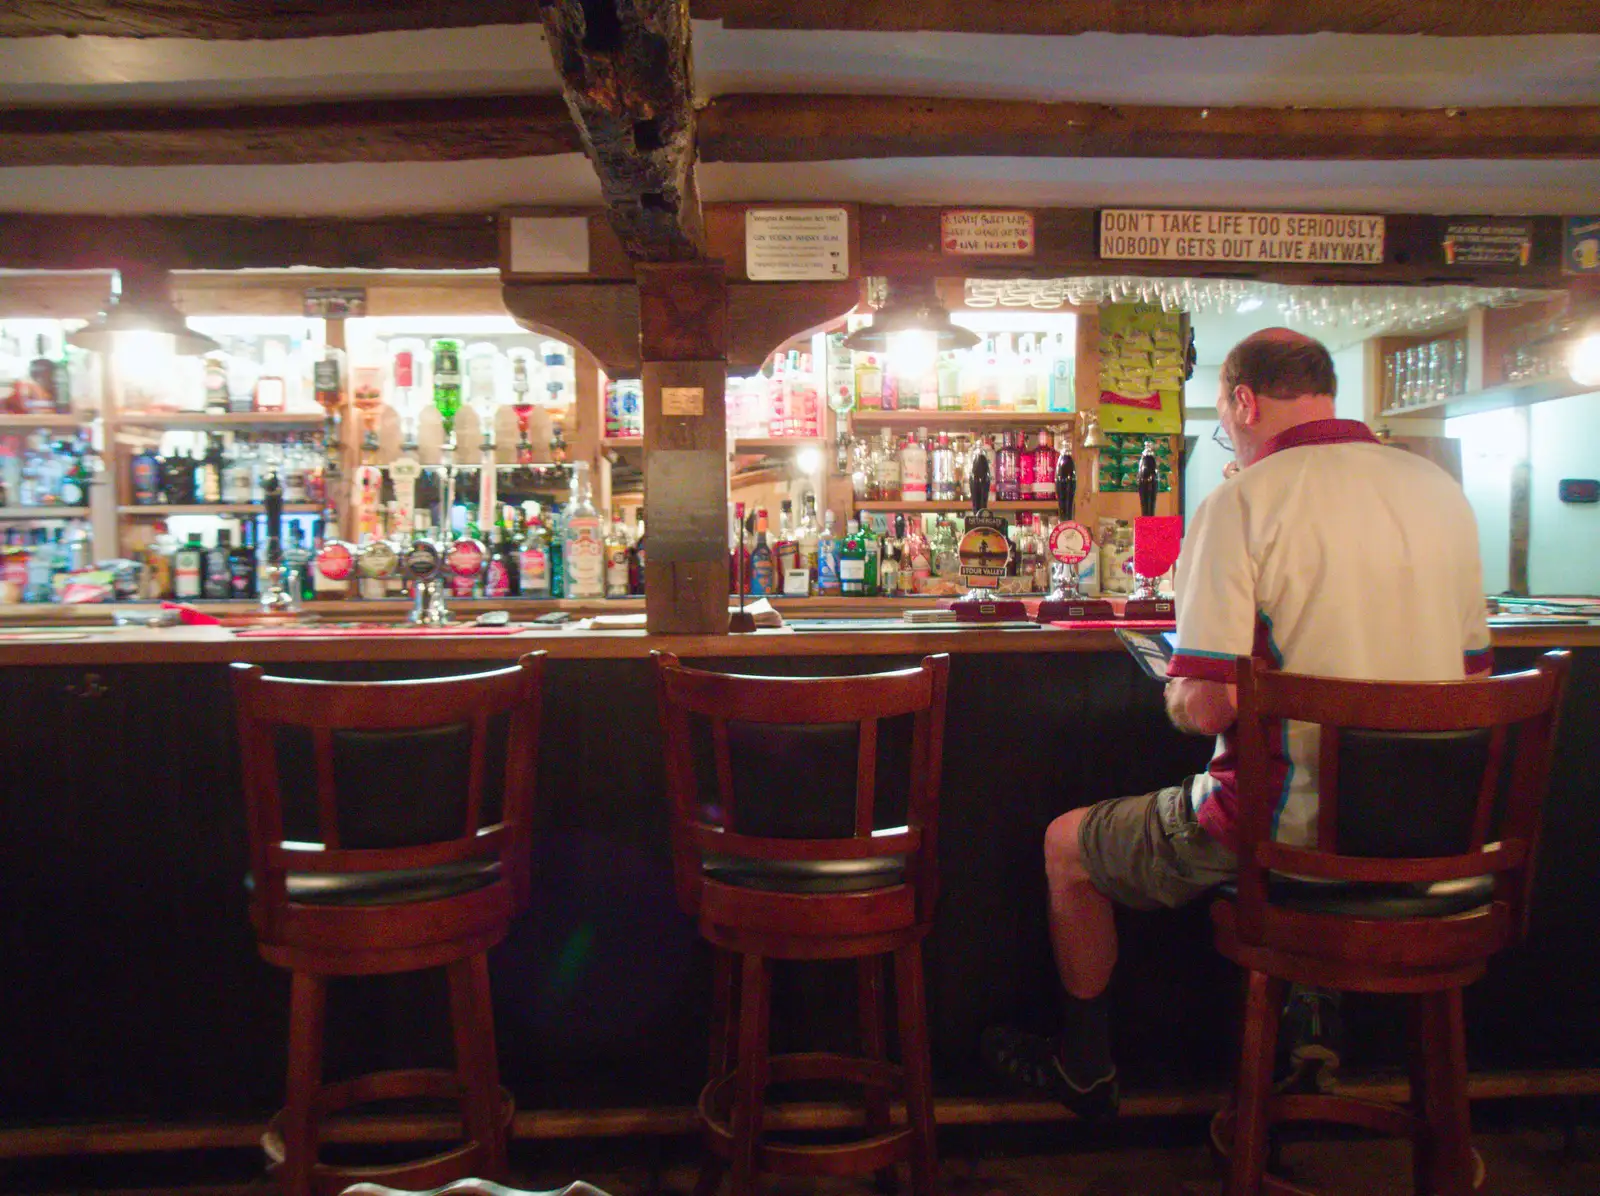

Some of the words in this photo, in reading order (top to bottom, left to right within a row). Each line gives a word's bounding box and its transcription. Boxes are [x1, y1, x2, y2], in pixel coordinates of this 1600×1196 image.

[1104, 212, 1155, 233] DON'T
[1160, 214, 1202, 233] TAKE
[1207, 215, 1243, 235] LIFE
[1248, 216, 1280, 236] TOO
[1103, 235, 1170, 256] NOBODY
[1176, 237, 1216, 257] GETS
[1222, 238, 1253, 258] OUT
[1259, 239, 1304, 260] ALIVE
[962, 567, 982, 575] STOUR
[984, 567, 1004, 576] VALLEY
